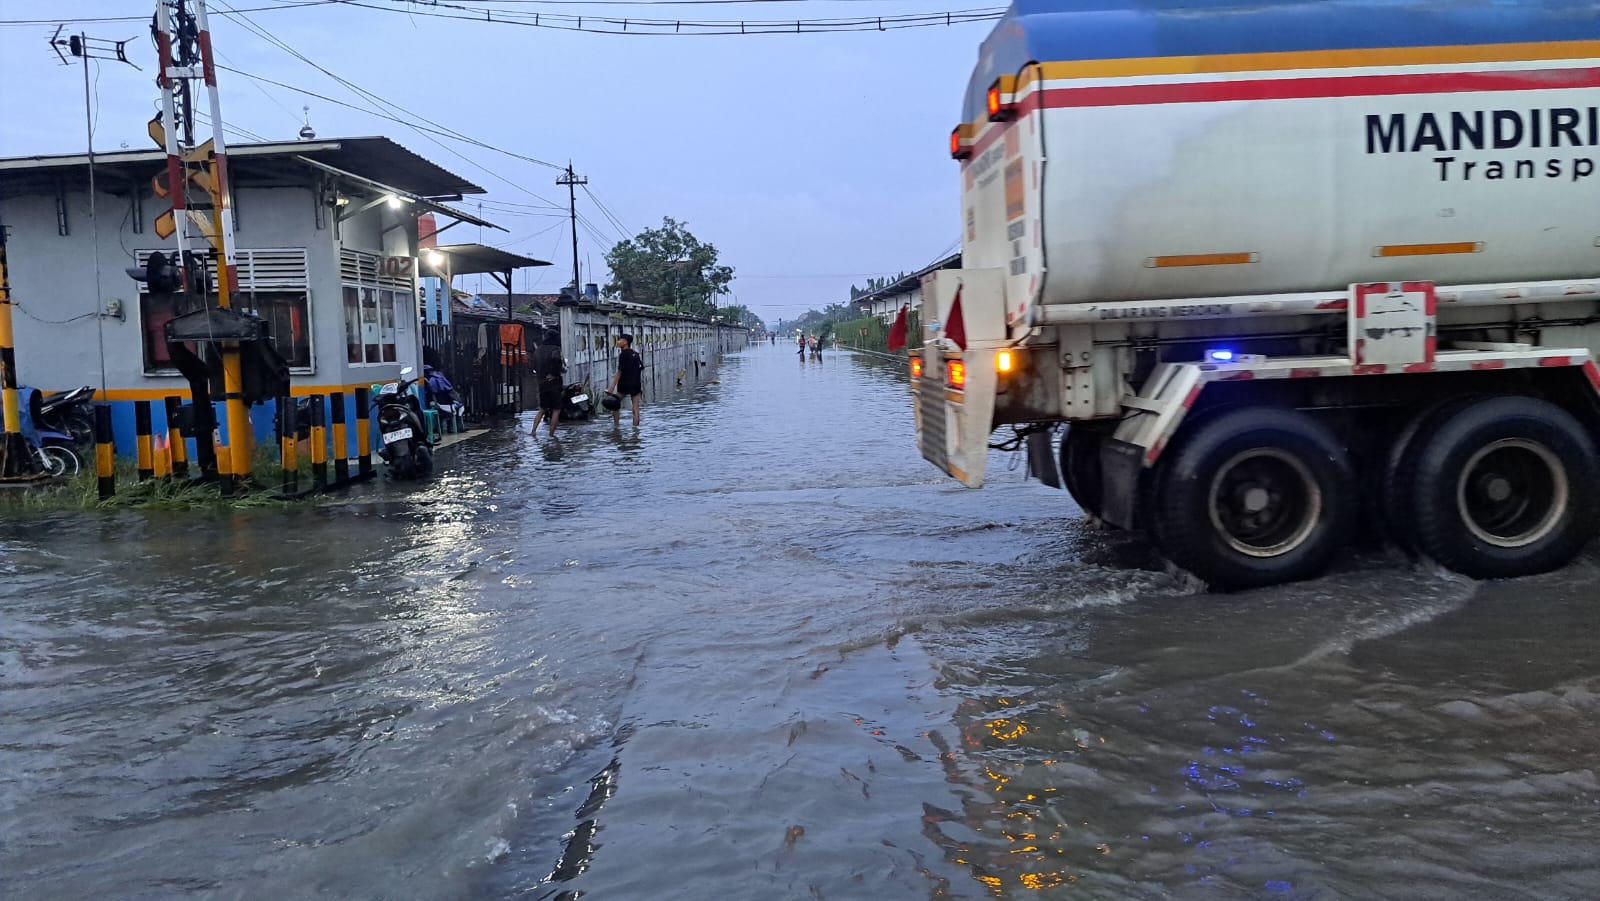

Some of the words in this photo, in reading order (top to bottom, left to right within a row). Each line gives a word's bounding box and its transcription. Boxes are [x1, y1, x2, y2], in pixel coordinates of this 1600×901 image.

[1365, 107, 1599, 154] MANDIRI
[1432, 156, 1595, 182] Transp
[378, 256, 413, 276] 102
